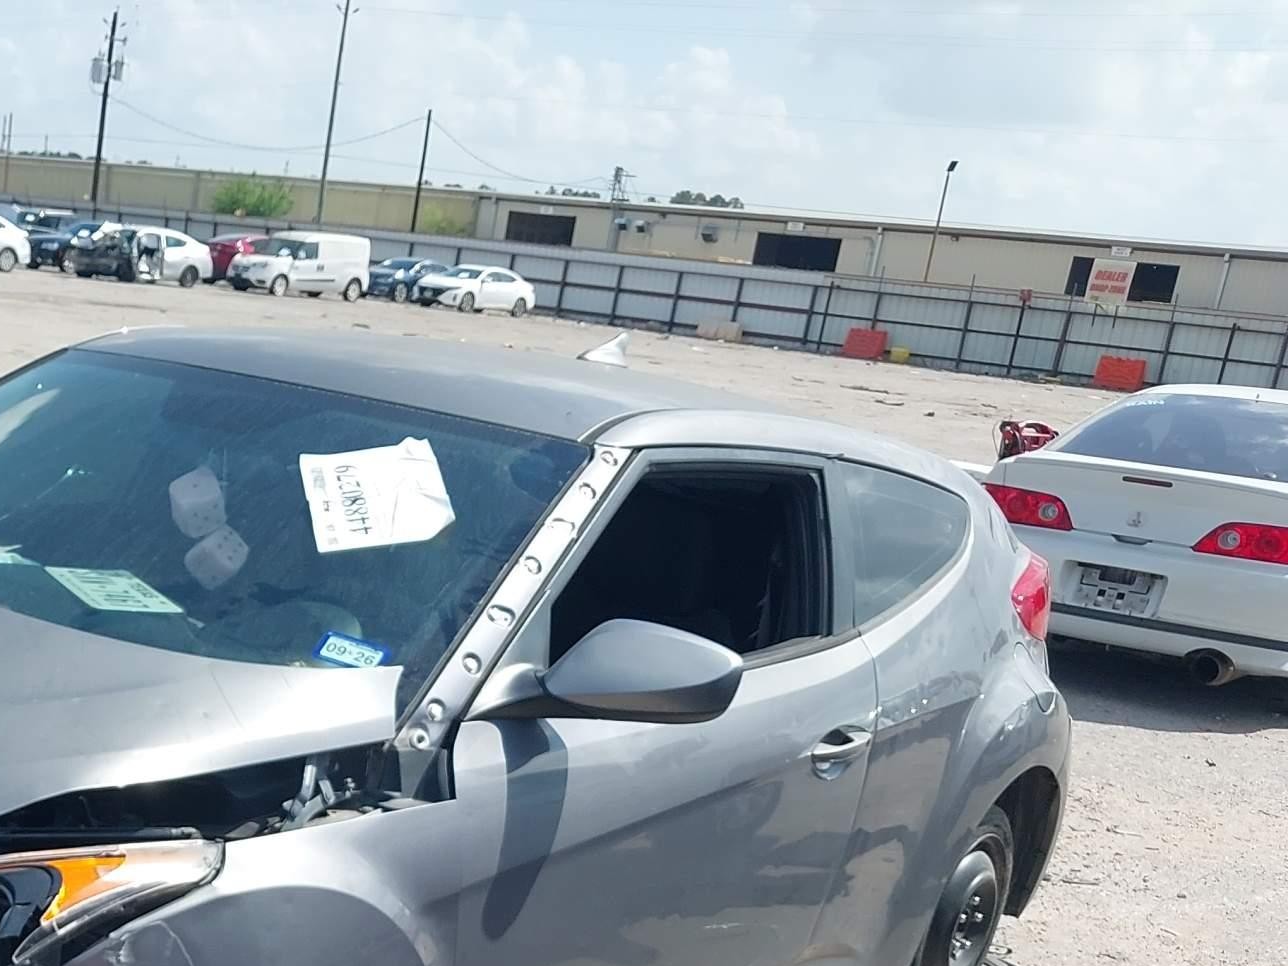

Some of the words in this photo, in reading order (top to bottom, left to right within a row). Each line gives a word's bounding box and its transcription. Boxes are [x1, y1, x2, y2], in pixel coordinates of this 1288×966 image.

[1095, 271, 1128, 282] DEALER
[334, 465, 373, 535] 44880279
[326, 643, 347, 656] 09
[353, 651, 375, 665] 26
